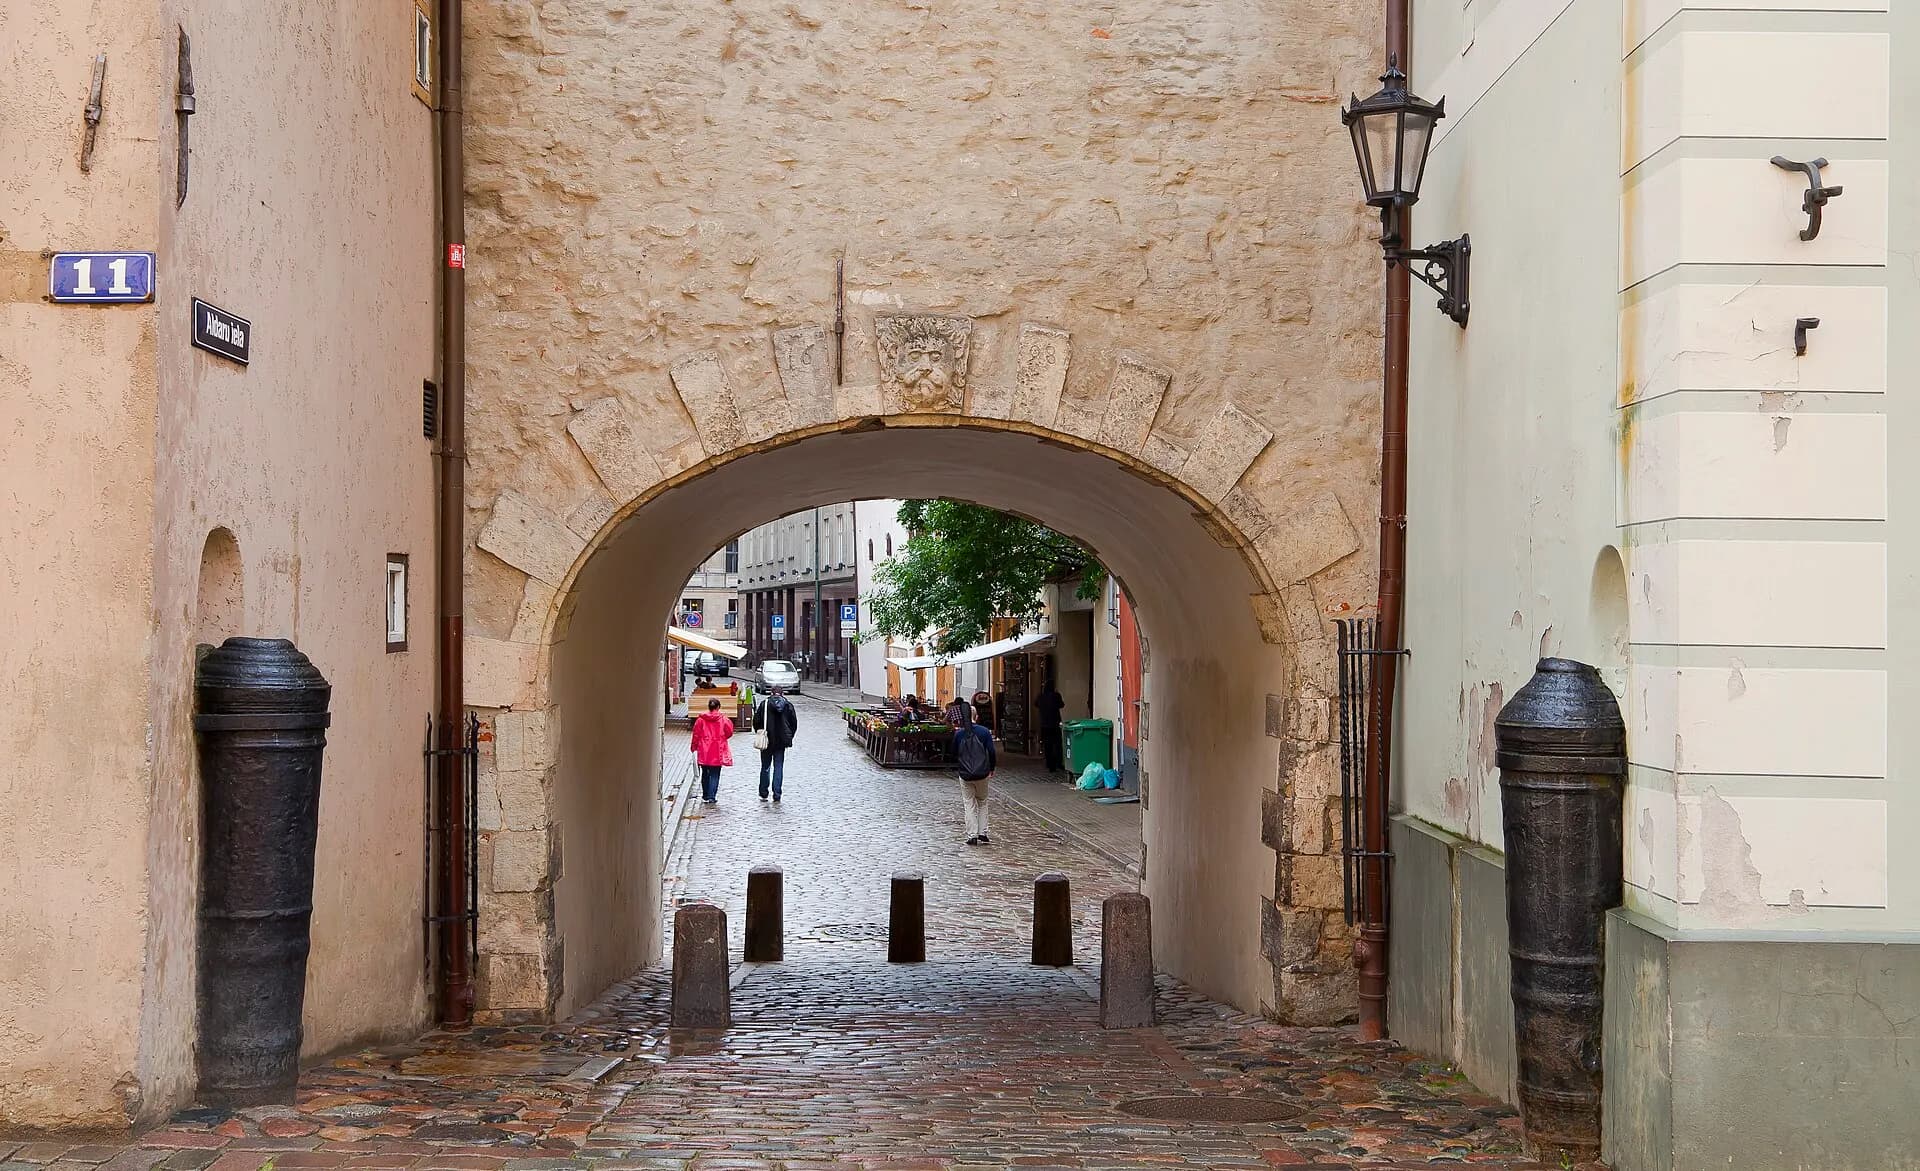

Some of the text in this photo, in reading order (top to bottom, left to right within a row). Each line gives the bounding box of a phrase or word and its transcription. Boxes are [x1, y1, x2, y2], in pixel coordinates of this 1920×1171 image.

[73, 259, 132, 294] 11
[206, 312, 245, 348] Aldaru iela
[774, 617, 782, 627] P
[844, 607, 853, 619] P
